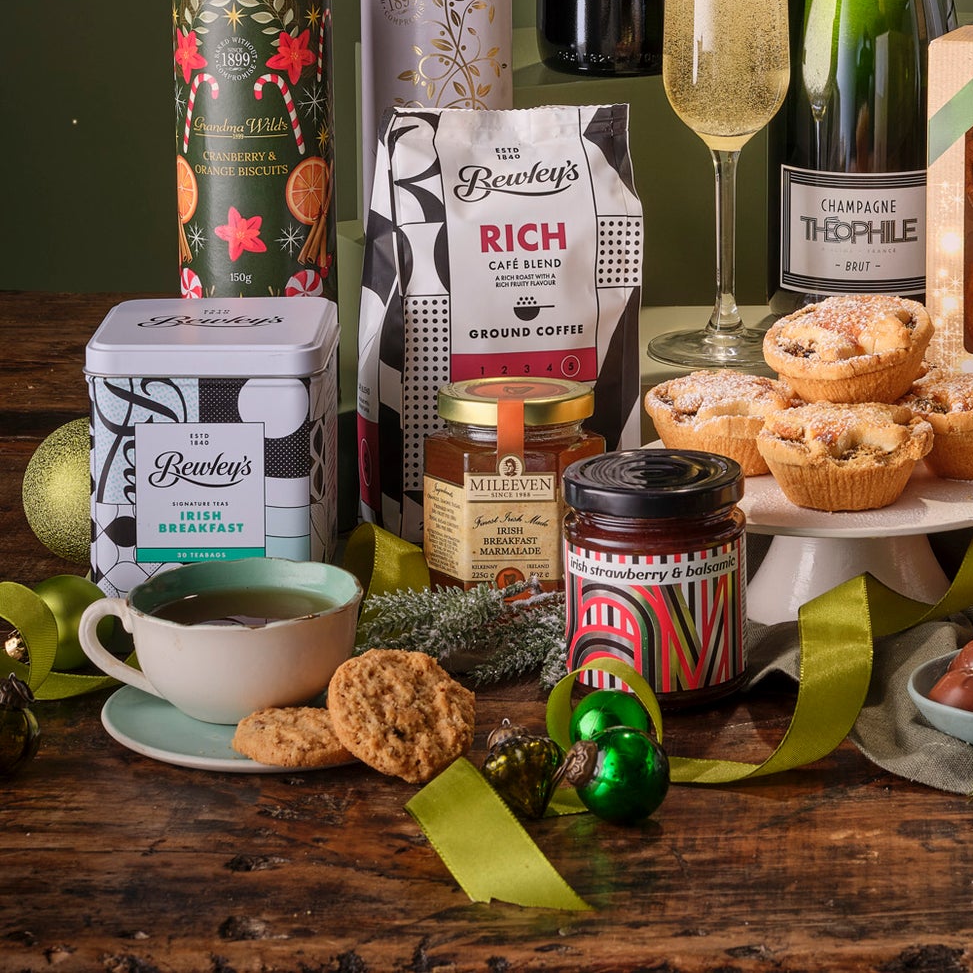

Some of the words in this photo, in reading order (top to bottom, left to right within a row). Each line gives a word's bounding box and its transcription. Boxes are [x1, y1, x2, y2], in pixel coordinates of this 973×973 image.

[222, 52, 250, 67] 1899
[193, 116, 244, 133] Grandma
[245, 117, 289, 133] Wild's
[203, 151, 266, 162] CRANBERRY
[268, 151, 277, 161] &
[194, 165, 235, 176] ORANGE
[238, 164, 289, 176] BISCUITS
[453, 159, 580, 203] Bewley's
[821, 198, 897, 214] CHAMPAGNE
[800, 215, 918, 245] THÉOPHILE
[479, 222, 567, 253] RICH
[488, 257, 519, 271] CAFÉ
[523, 258, 562, 269] BLEND
[845, 261, 871, 272] BRUT
[230, 273, 252, 284] 150g
[137, 315, 285, 327] Bewley's
[469, 327, 530, 339] GROUND
[536, 324, 584, 336] COFFEE
[501, 366, 508, 375] 2
[524, 364, 530, 374] 3
[546, 363, 553, 372] 4
[568, 361, 574, 371] 5
[148, 450, 252, 488] Bewley's
[469, 478, 552, 492] MILEEVEN
[180, 511, 222, 521] IRISH
[158, 523, 244, 533] BREAKFAST
[483, 537, 537, 545] BREAKFAST
[480, 547, 541, 555] MARMALADE
[570, 556, 588, 573] irish
[590, 565, 668, 582] strawberry
[671, 568, 683, 579] &
[686, 556, 736, 578] balsamic
